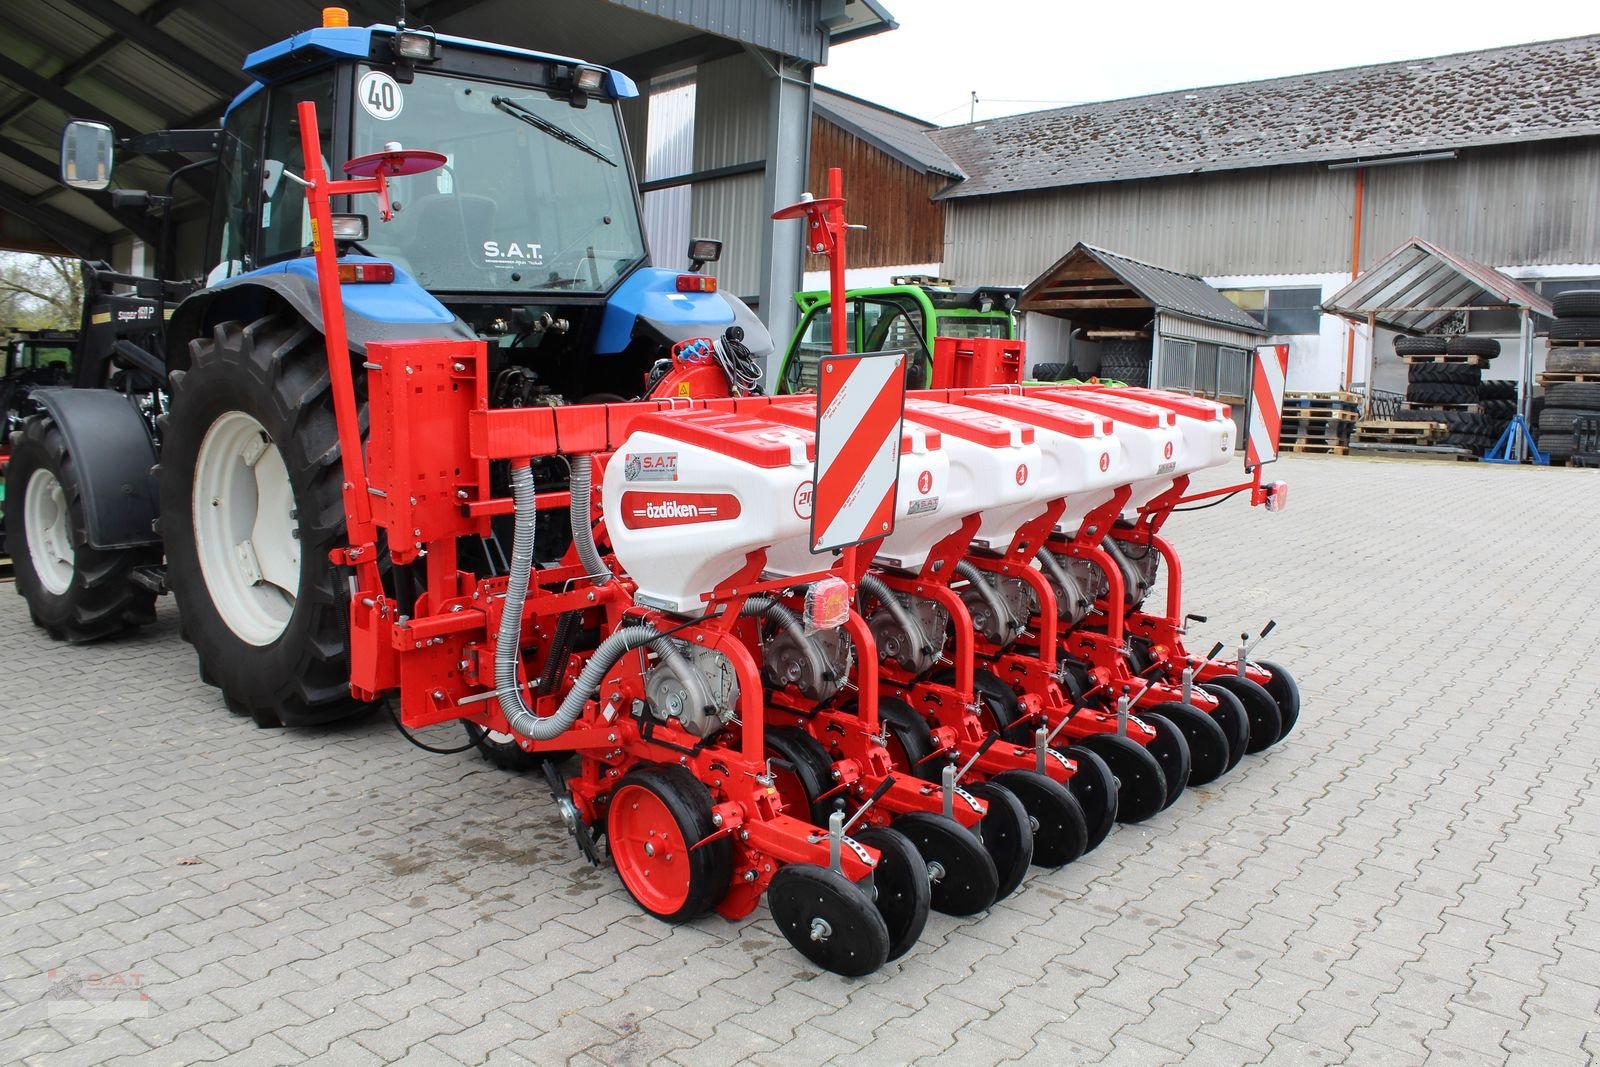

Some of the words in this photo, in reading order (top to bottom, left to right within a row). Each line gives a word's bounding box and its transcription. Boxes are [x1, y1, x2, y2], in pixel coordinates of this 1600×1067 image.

[368, 80, 394, 111] 40
[484, 241, 542, 259] S.A.T.
[643, 455, 676, 468] S.A.T.
[646, 500, 698, 518] özdöken
